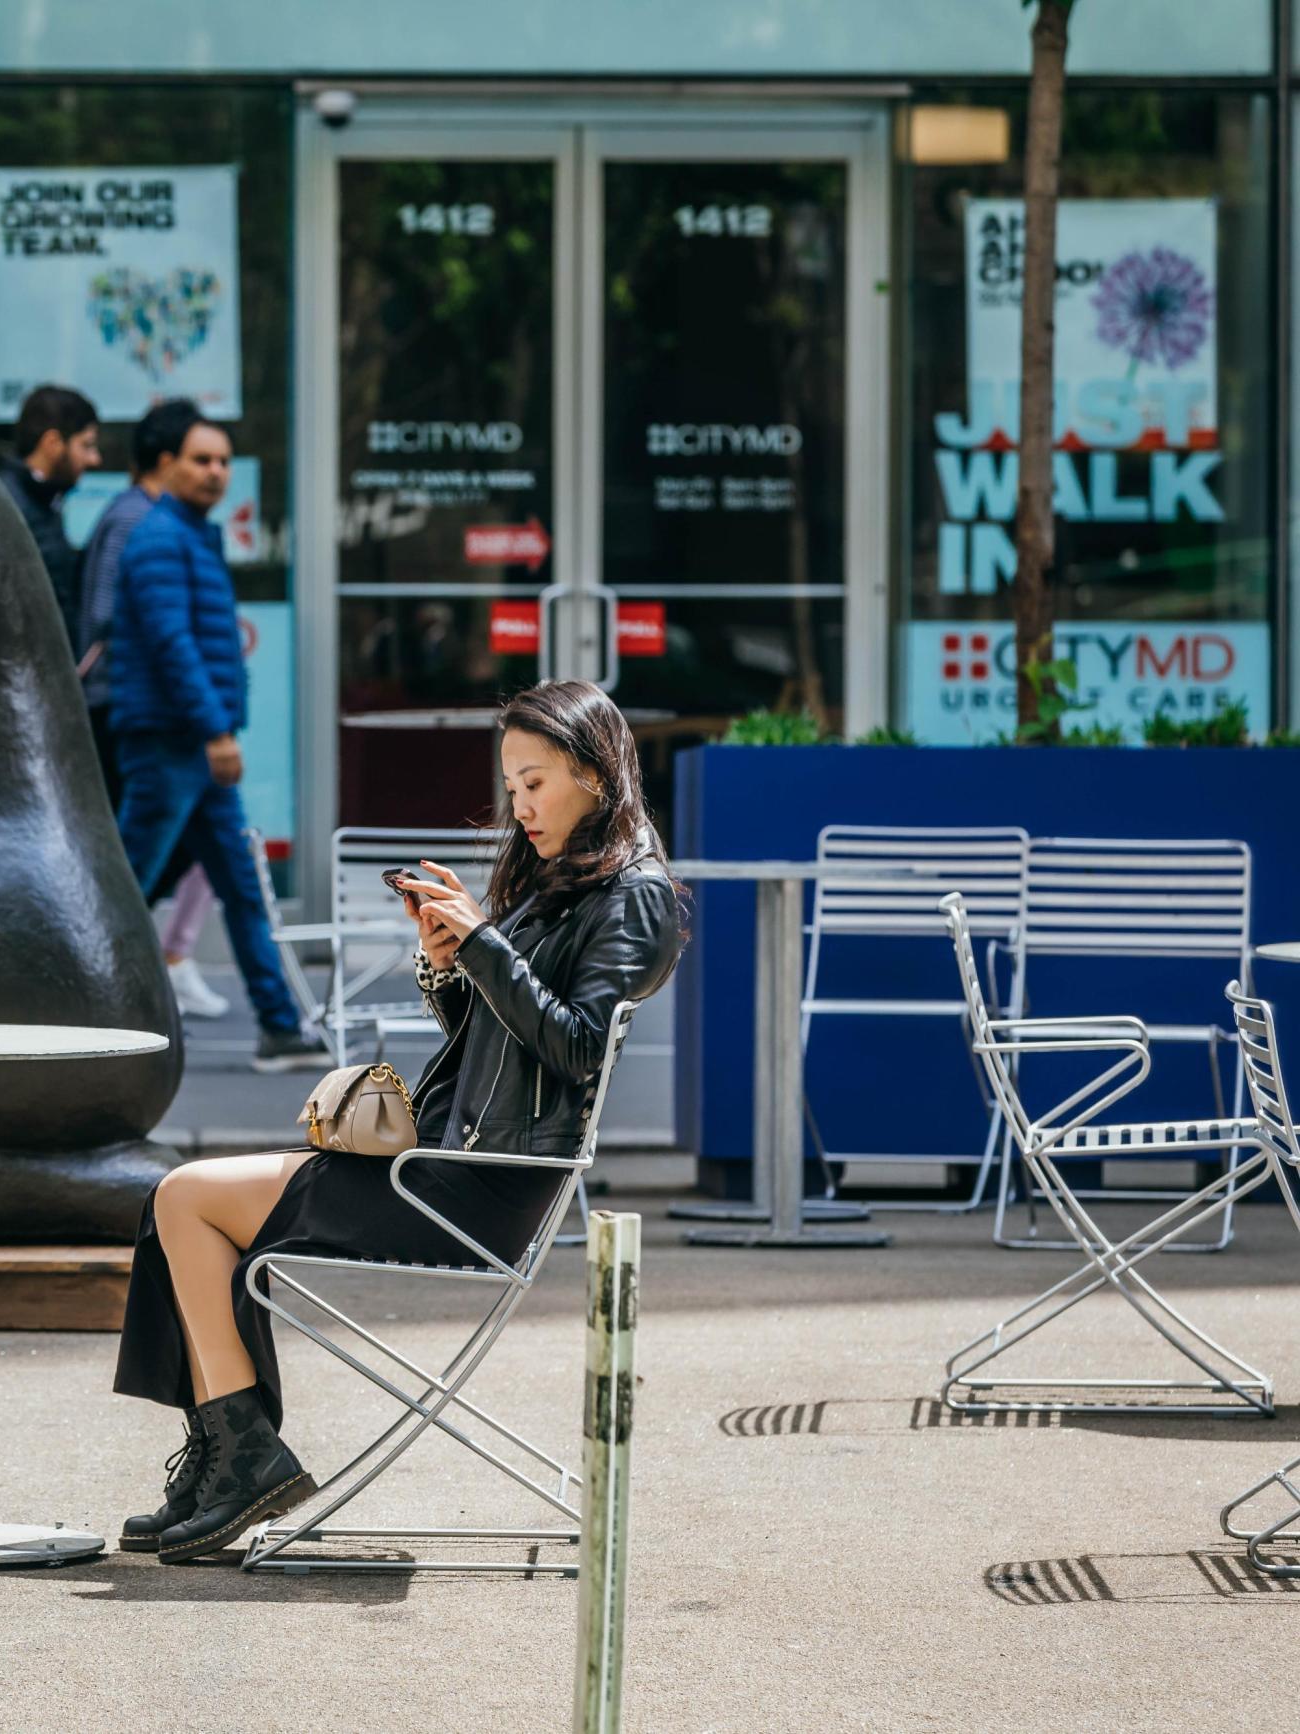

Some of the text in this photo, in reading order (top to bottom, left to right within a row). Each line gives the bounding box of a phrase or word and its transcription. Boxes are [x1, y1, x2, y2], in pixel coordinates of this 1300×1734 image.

[1, 181, 173, 202] JOIN OUR
[0, 205, 175, 231] GROWING
[398, 205, 495, 236] 1412
[675, 205, 772, 237] 1412
[401, 422, 523, 452] CITYMD
[676, 424, 802, 454] CITYMD
[934, 450, 1226, 521] WALK
[994, 634, 1236, 682] CTYMD
